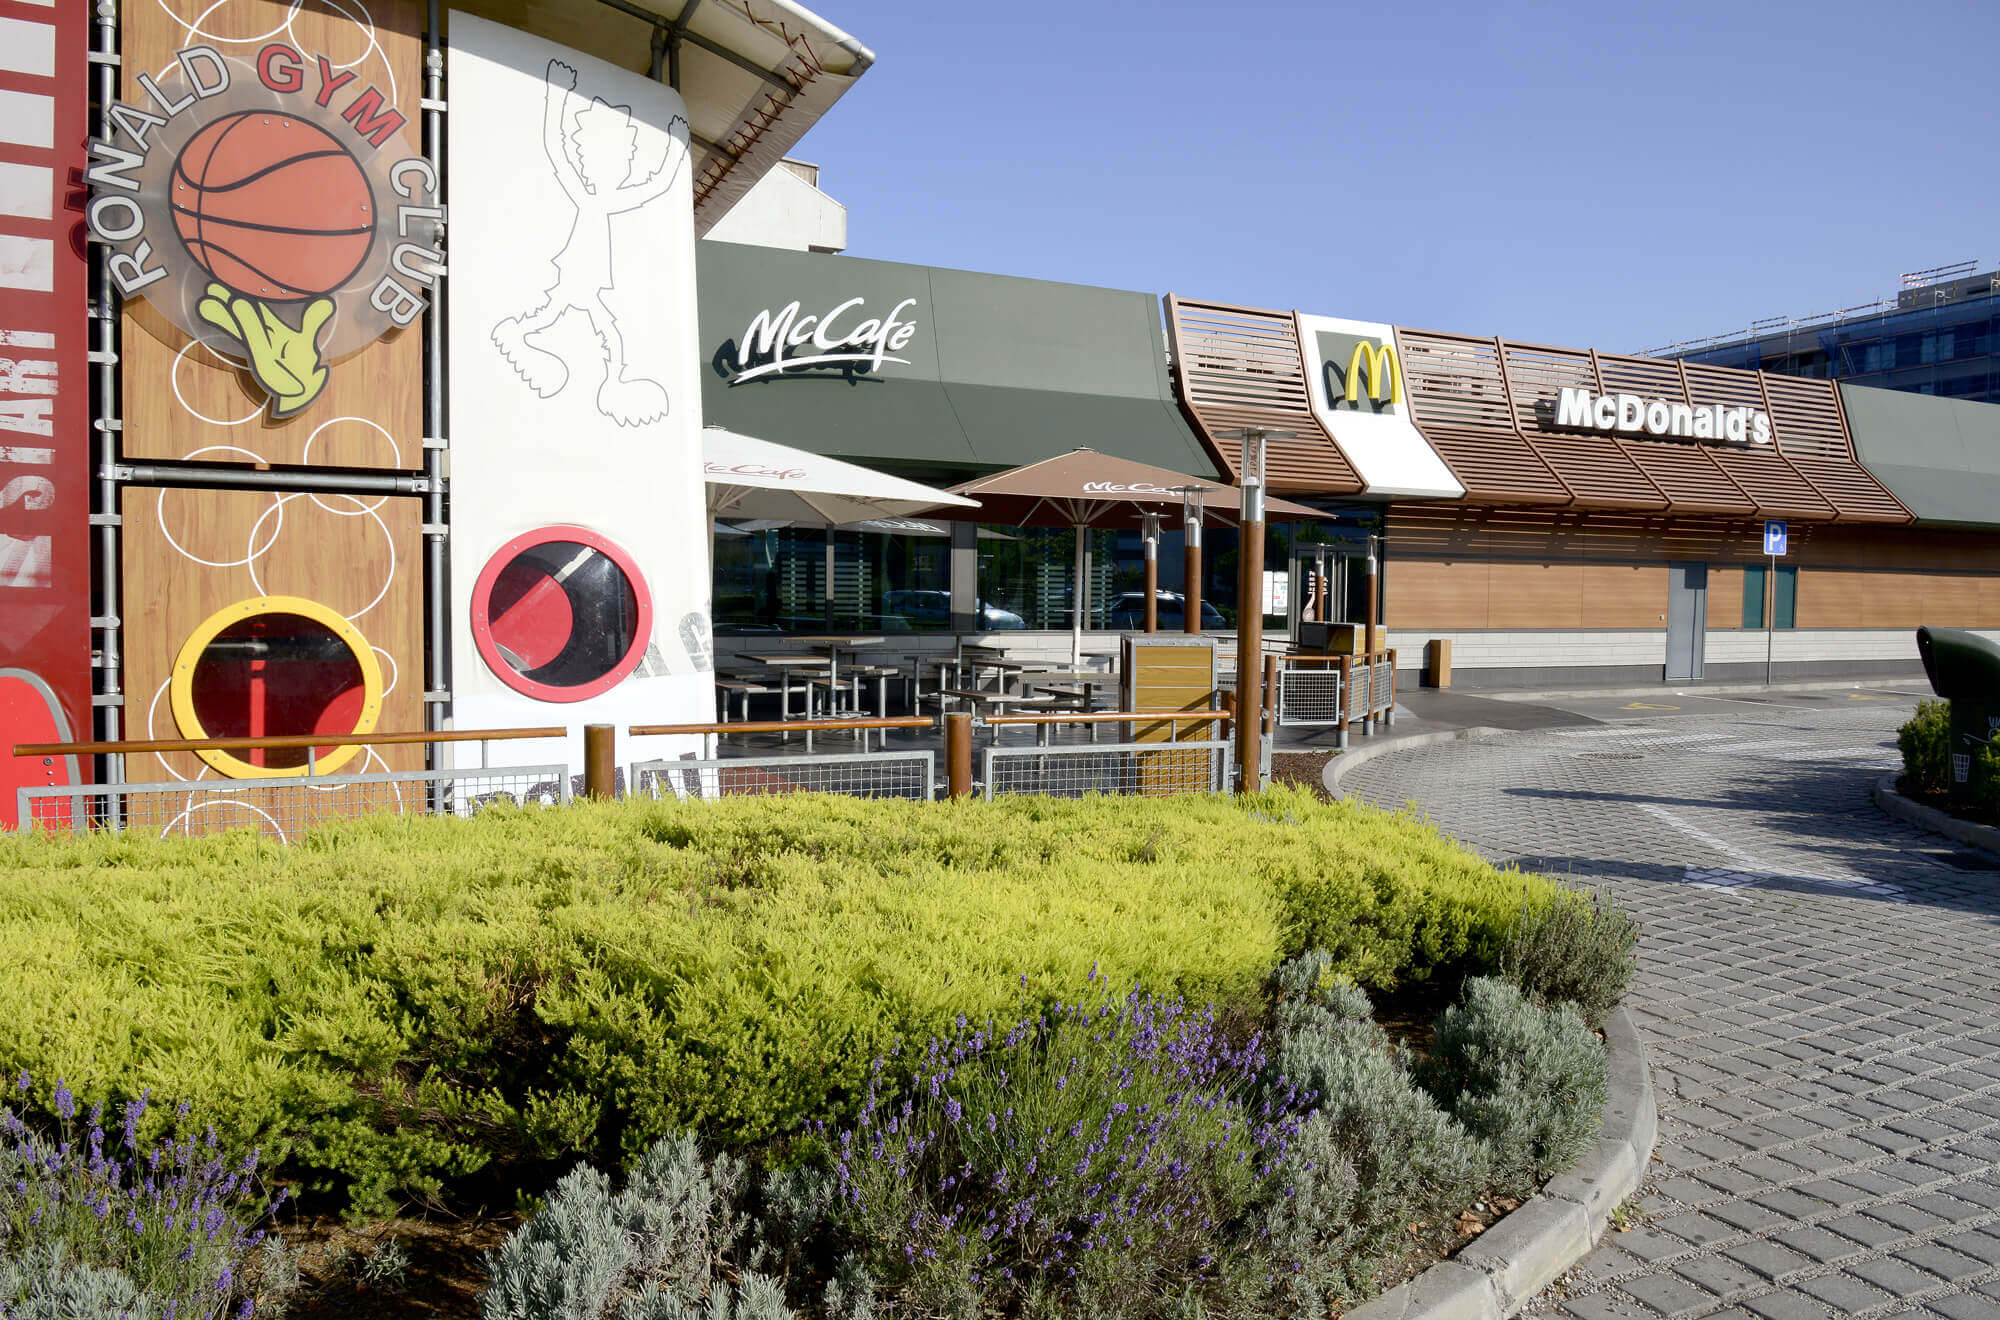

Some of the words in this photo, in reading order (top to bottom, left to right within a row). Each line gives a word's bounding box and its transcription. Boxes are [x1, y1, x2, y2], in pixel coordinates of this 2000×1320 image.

[86, 44, 232, 295] RONALD
[256, 42, 408, 150] GYM
[368, 157, 448, 327] CLUB
[732, 296, 917, 384] McCafé
[1553, 386, 1772, 445] McDonald's
[1082, 481, 1194, 497] McCaf
[1768, 523, 1783, 552] P
